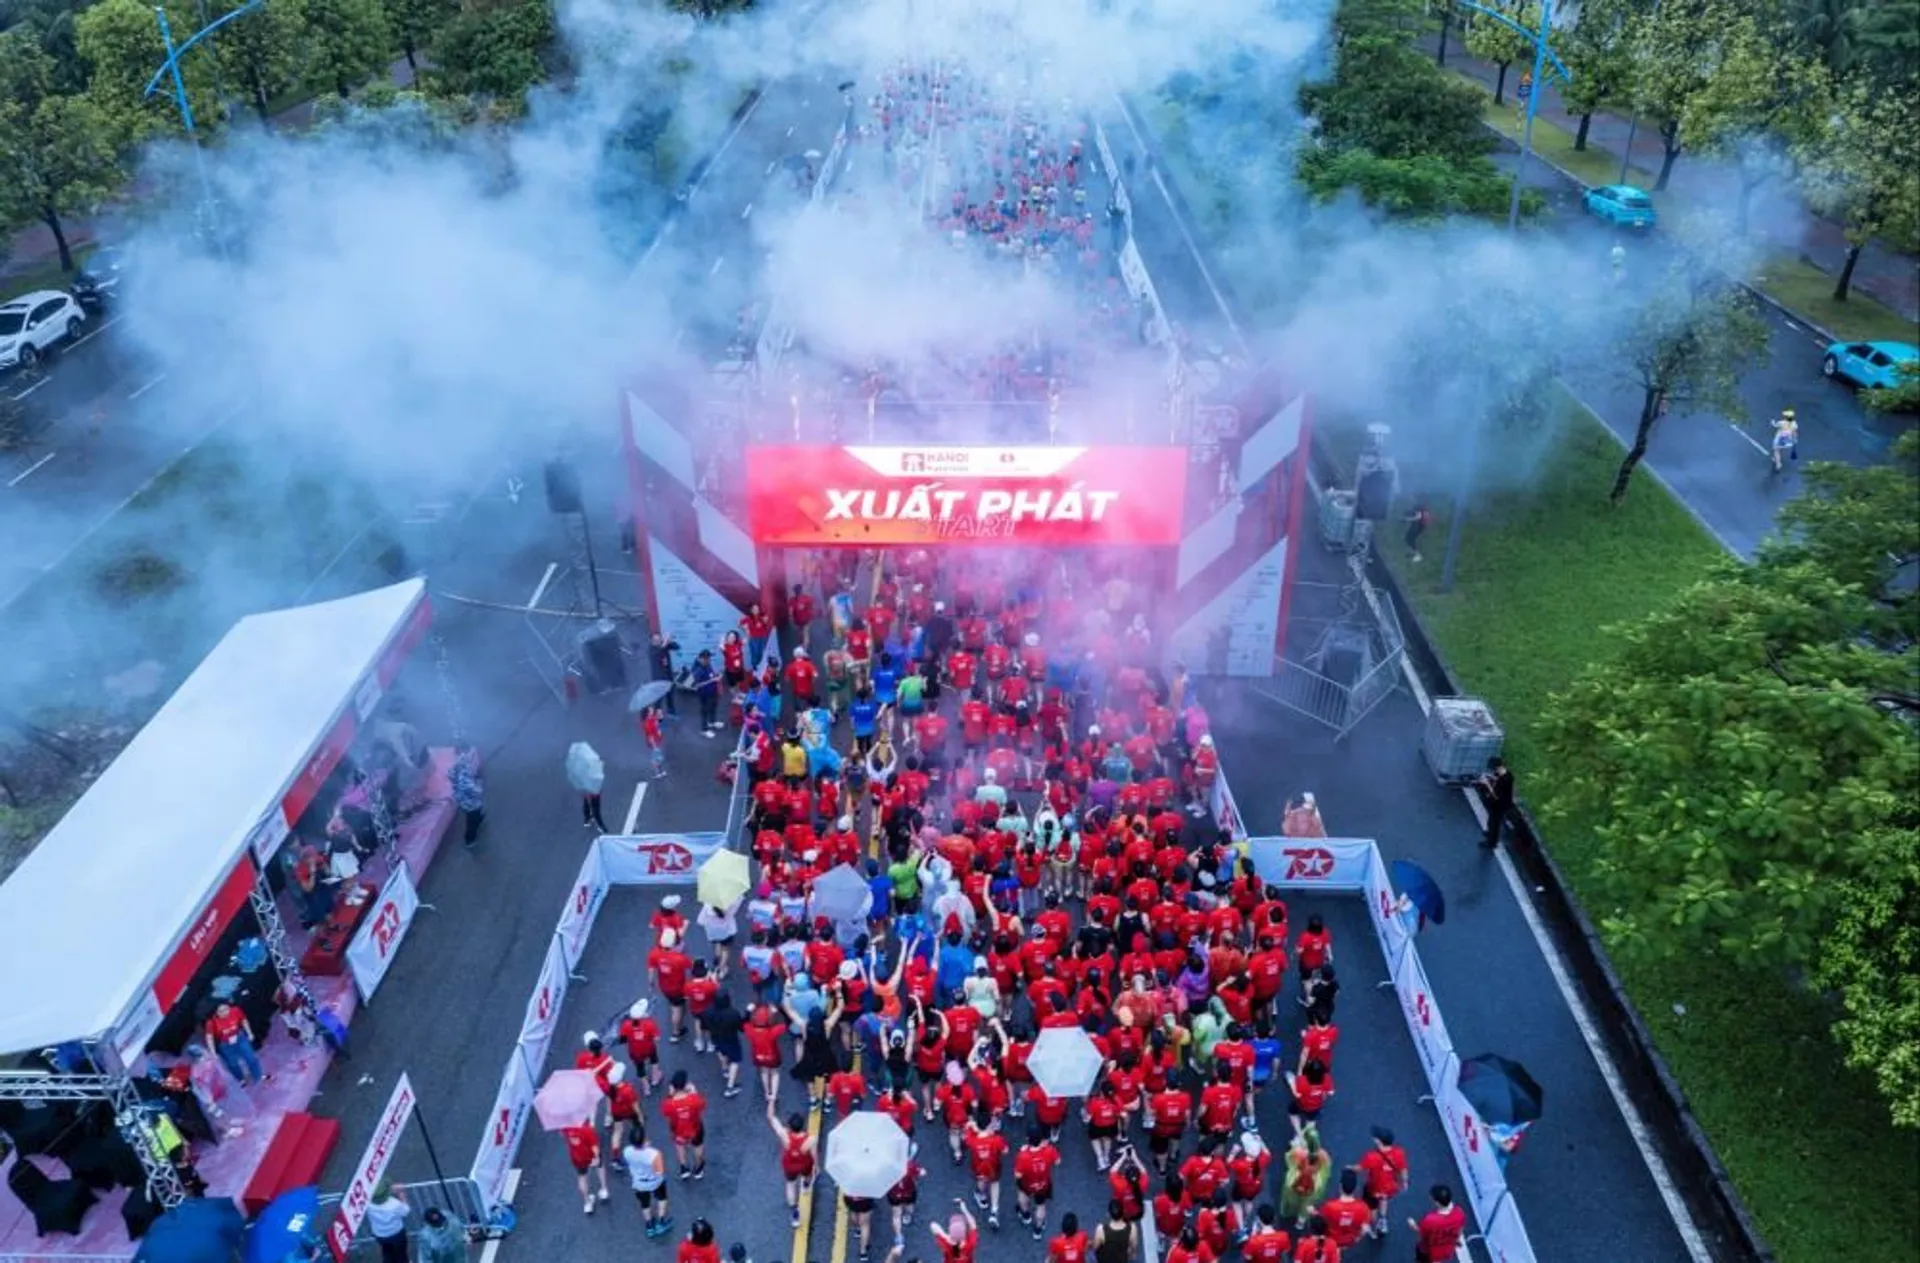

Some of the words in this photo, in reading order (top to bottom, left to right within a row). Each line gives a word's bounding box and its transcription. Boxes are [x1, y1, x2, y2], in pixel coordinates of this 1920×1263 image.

[824, 482, 967, 521] XUẤT
[976, 480, 1120, 522] PHÁT
[637, 842, 693, 875] 70
[1282, 847, 1335, 880] 70
